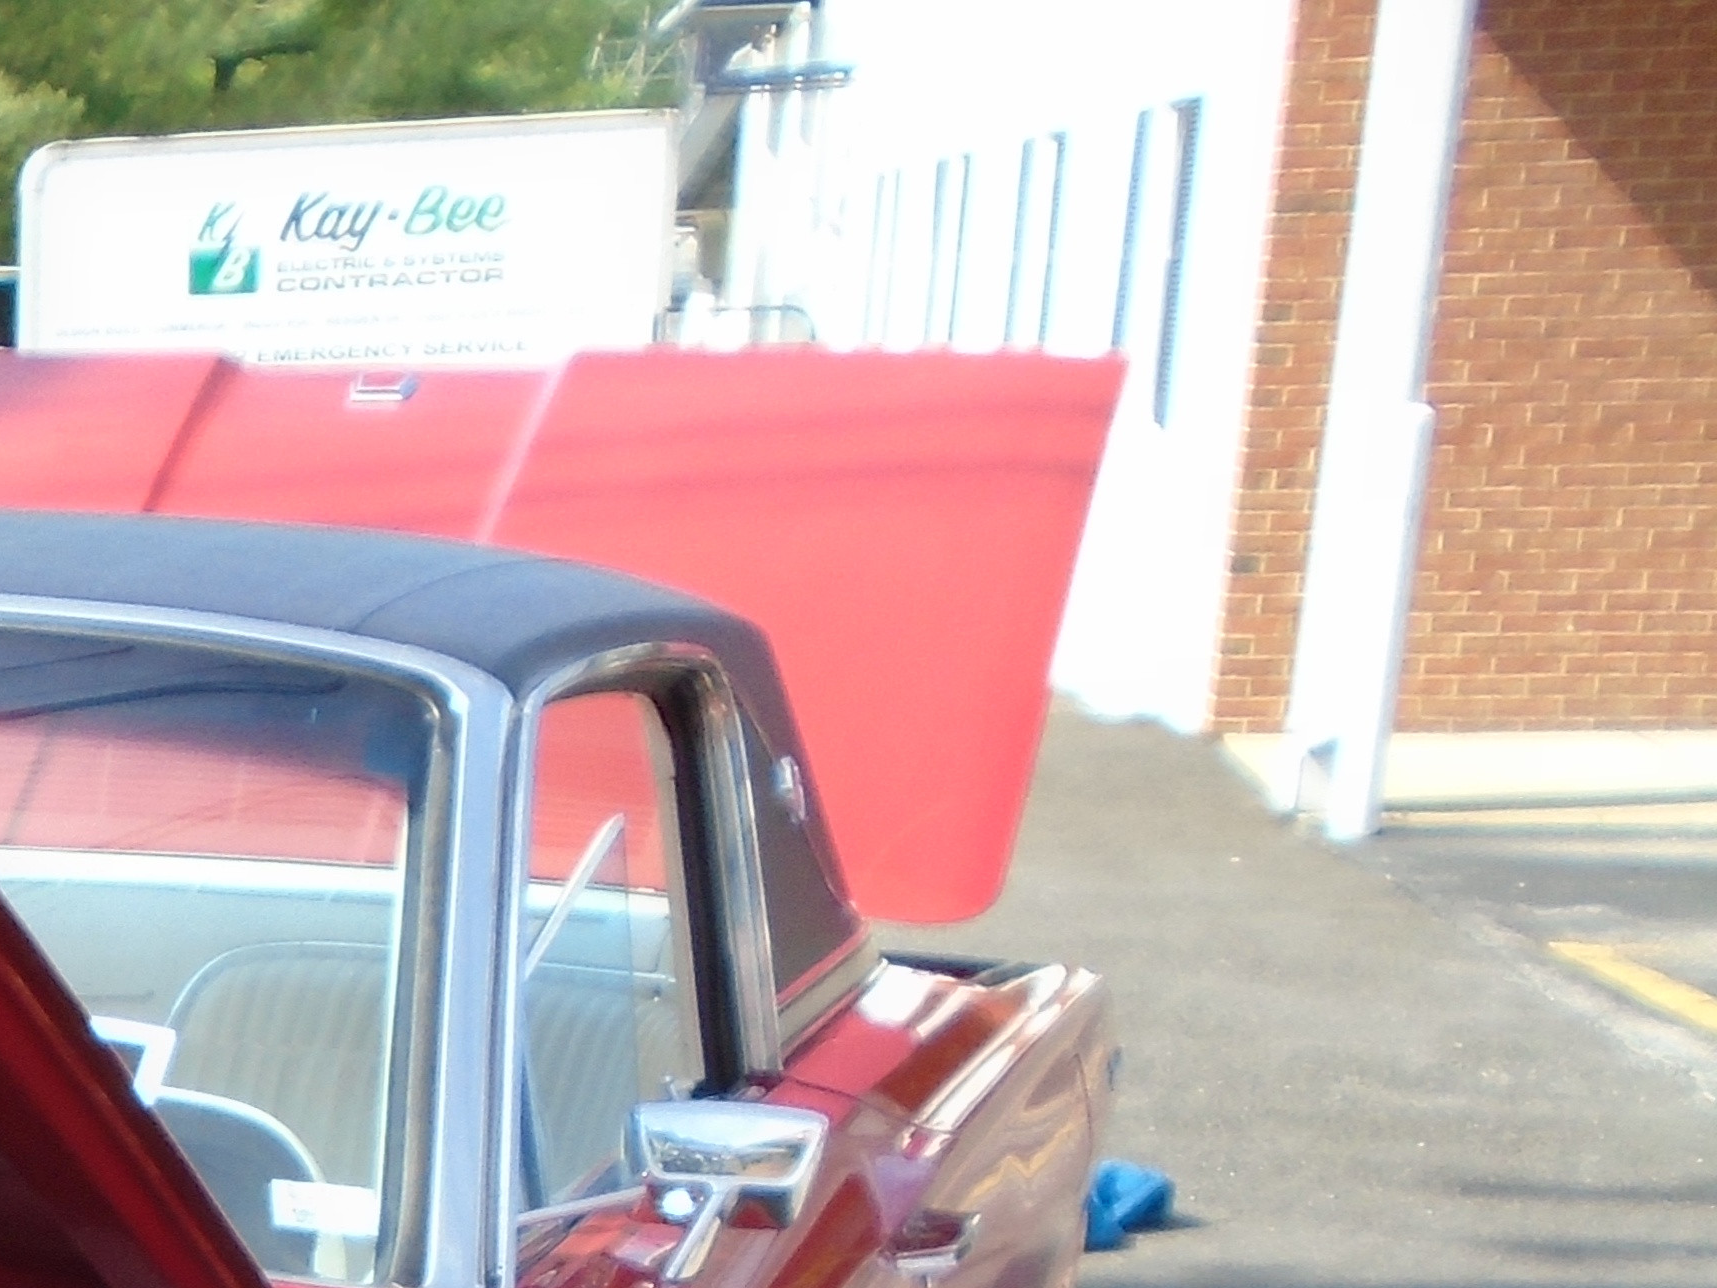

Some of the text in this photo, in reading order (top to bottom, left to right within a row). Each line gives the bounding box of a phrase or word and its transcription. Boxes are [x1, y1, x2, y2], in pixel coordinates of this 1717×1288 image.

[276, 256, 374, 273] ELECTRIC
[403, 251, 505, 266] SYSTEMS
[276, 267, 504, 293] CONTRACTOR
[256, 341, 412, 363] EMERGENCY
[423, 338, 531, 356] SERVICE
